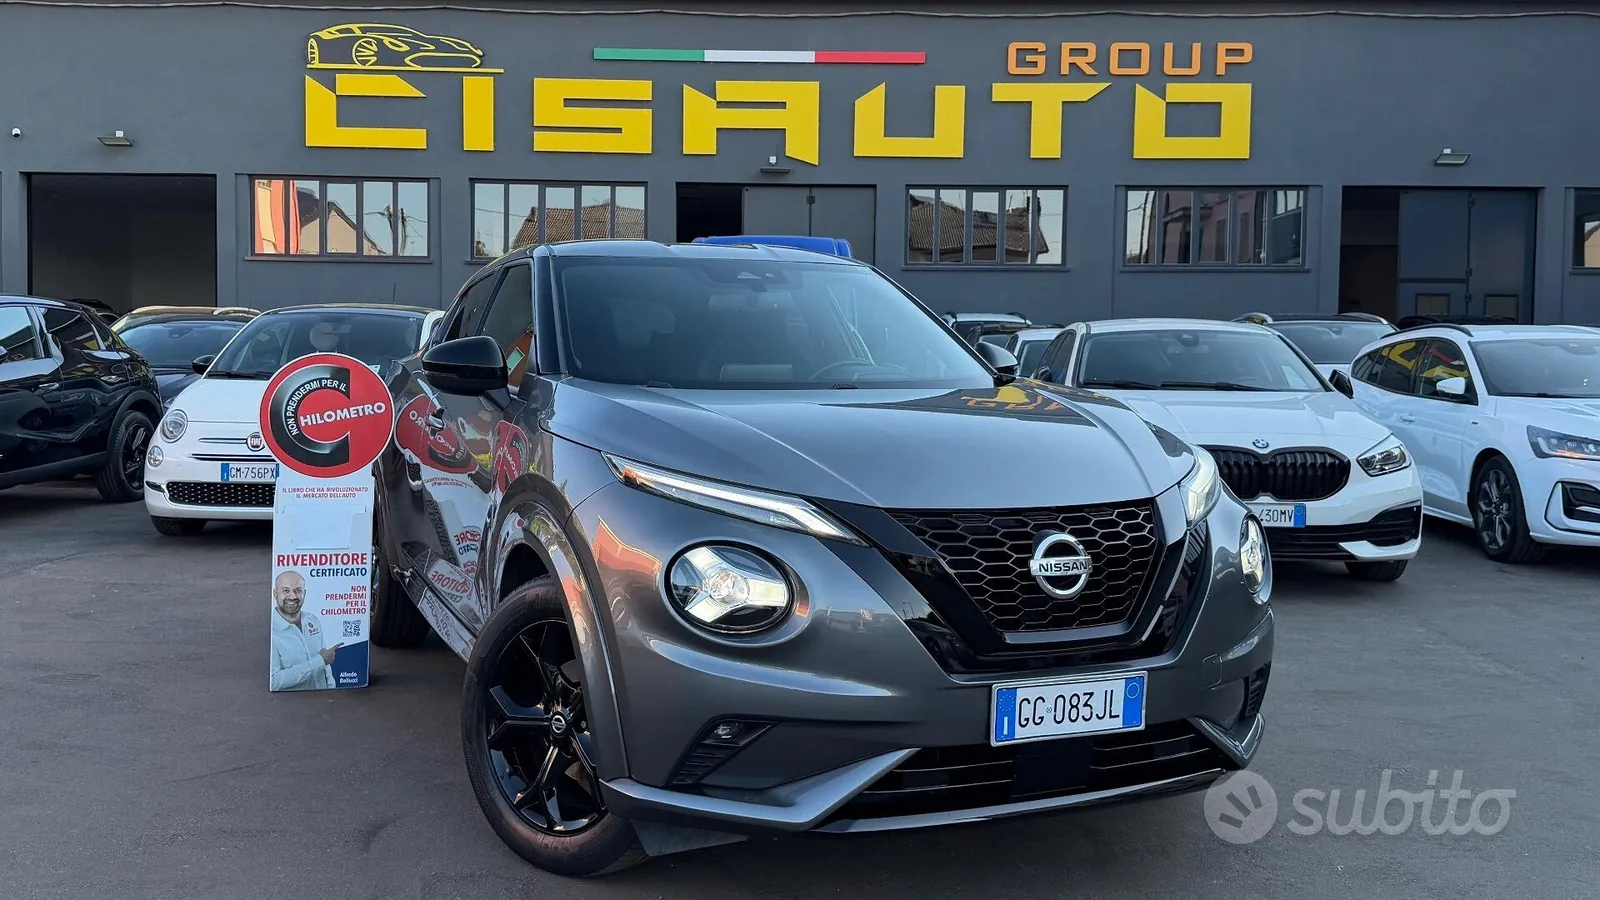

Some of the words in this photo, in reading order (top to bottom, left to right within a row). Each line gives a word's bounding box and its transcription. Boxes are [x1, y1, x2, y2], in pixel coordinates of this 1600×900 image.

[1007, 42, 1253, 76] GROUP
[305, 74, 1252, 166] CISAUTO
[321, 379, 339, 388] PER
[339, 382, 347, 392] IL
[287, 380, 320, 417] PRENDERMI
[287, 417, 299, 436] NON
[277, 553, 368, 567] RIVENDITORE
[309, 567, 368, 578] CERTIFICATO
[1038, 560, 1088, 573] NISSAN
[350, 585, 367, 593] NON
[325, 592, 367, 601] PRENDERMI
[320, 607, 367, 616] CHILOMETRO
